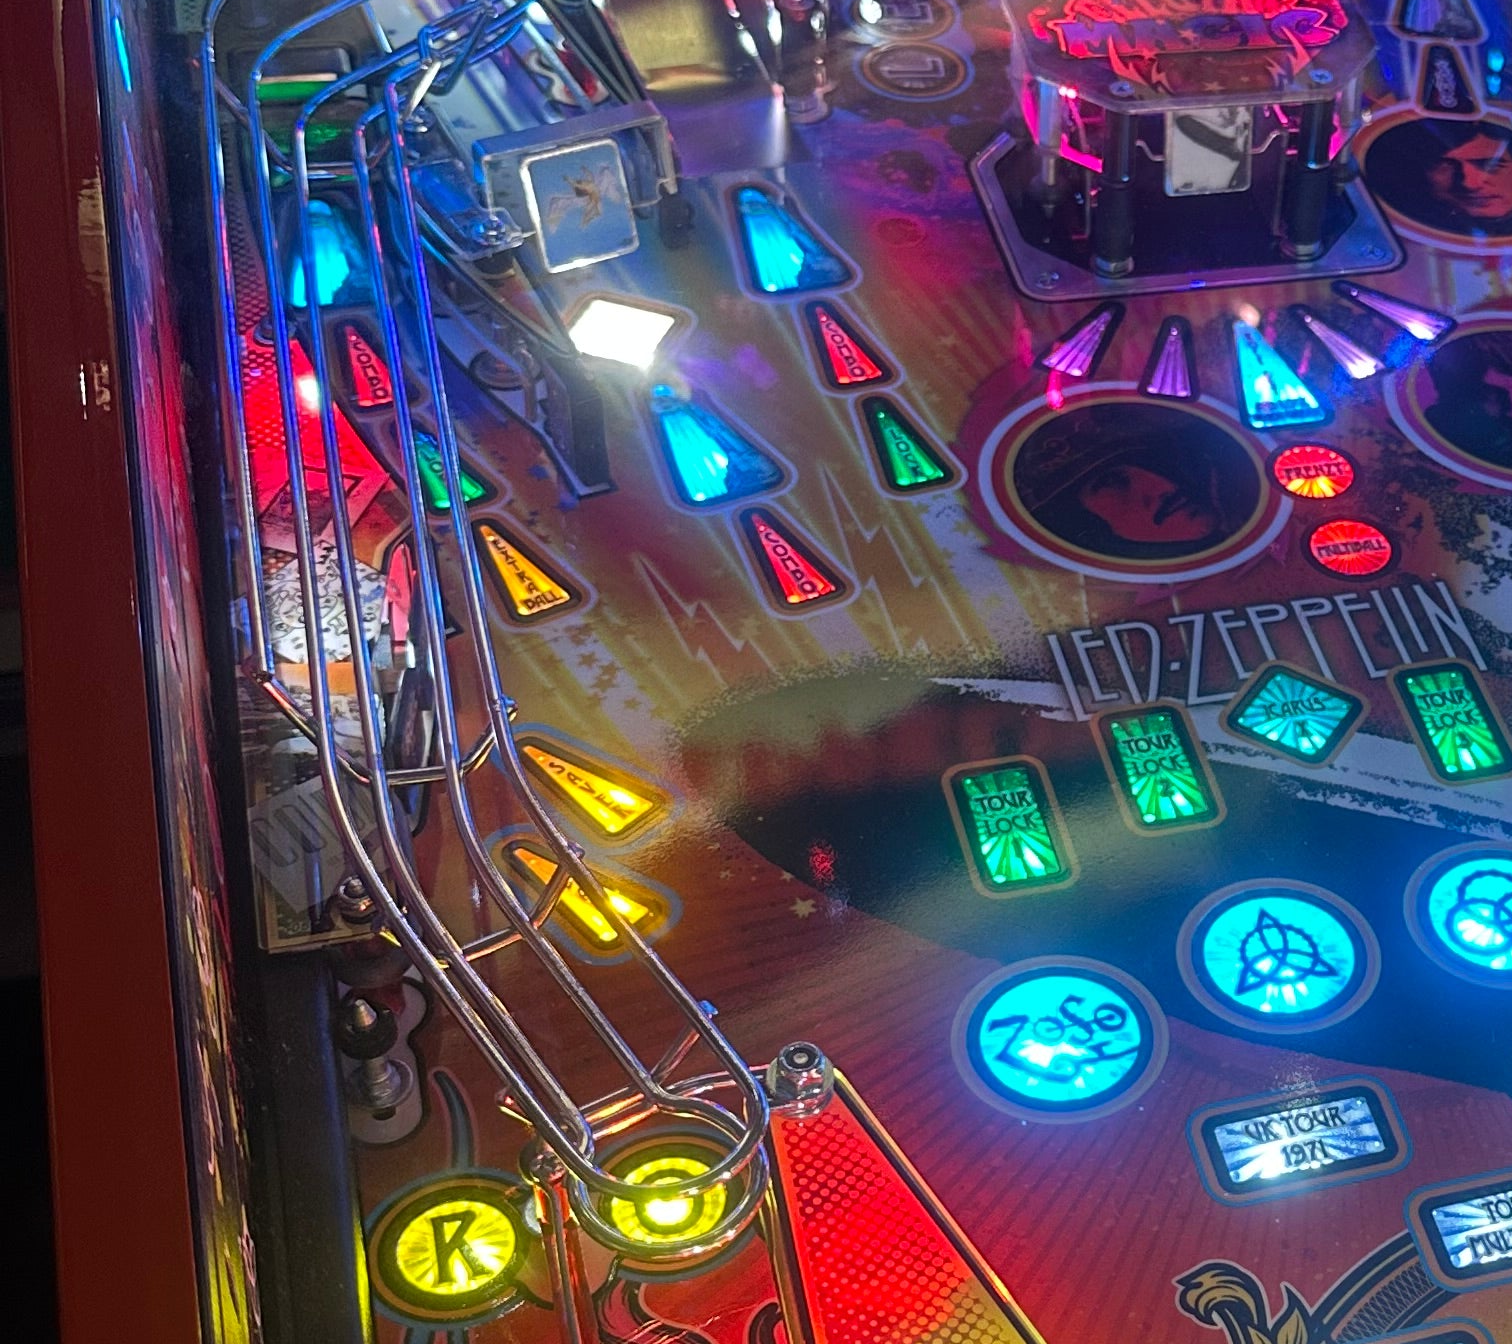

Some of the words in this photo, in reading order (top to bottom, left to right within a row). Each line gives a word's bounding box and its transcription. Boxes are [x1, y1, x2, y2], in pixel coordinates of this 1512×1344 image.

[1315, 536, 1388, 558] MULTIBALL
[1265, 696, 1327, 721] ICARUS
[1419, 688, 1469, 709] TOUR
[1431, 708, 1480, 729] LOCK
[1121, 733, 1176, 756] TOUR
[1131, 754, 1184, 776] LOCK
[973, 788, 1031, 814] TOUR
[983, 812, 1038, 837] LOCK
[1243, 1117, 1279, 1143] UK
[1279, 1105, 1347, 1135] TOUR
[1280, 1139, 1329, 1169] 1971
[428, 1209, 494, 1286] R
